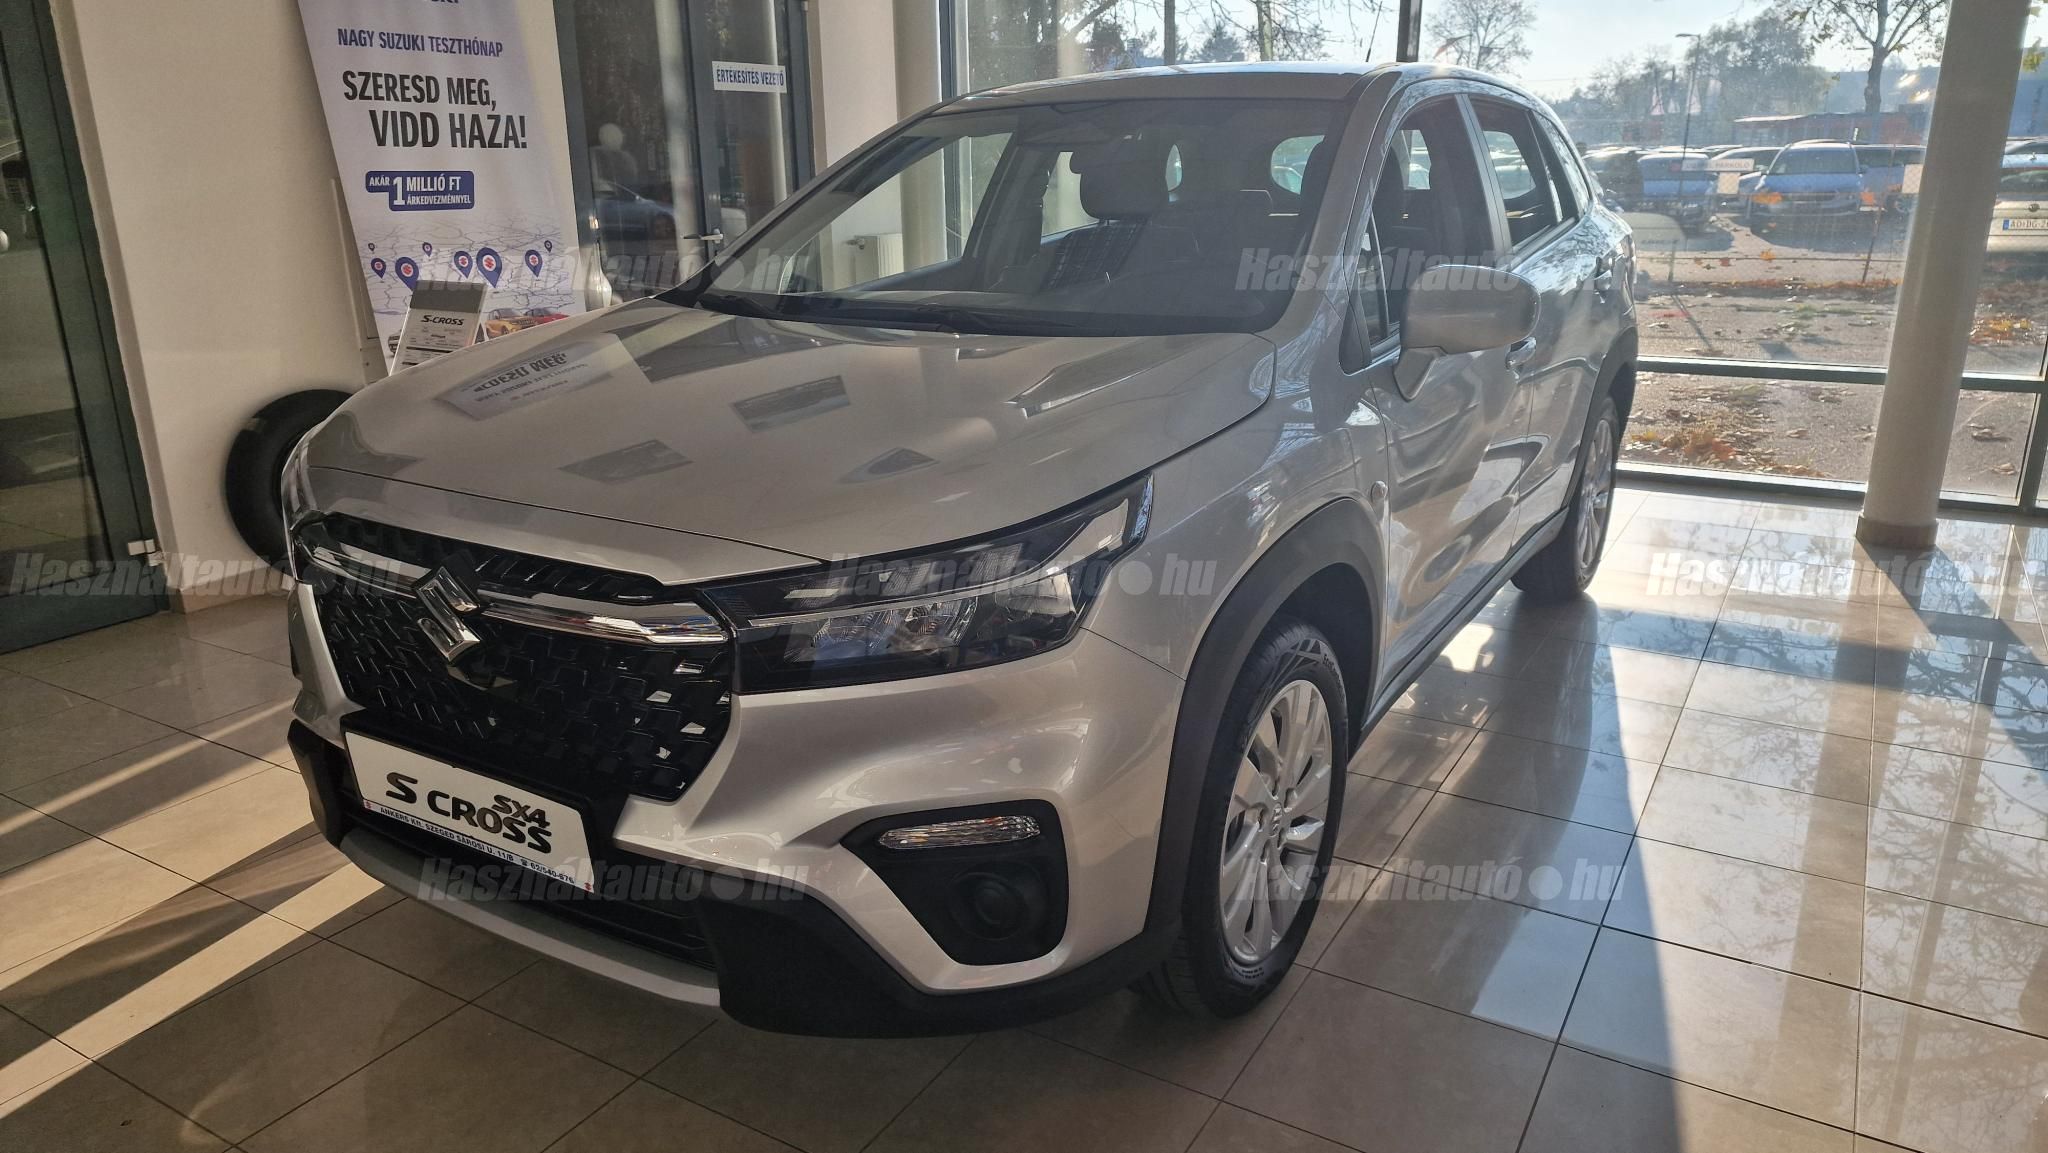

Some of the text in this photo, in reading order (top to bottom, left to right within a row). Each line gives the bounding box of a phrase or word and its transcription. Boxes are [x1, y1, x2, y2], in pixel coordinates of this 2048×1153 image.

[337, 28, 503, 57] NAGY SUZUKI TESZTHÓNAP
[342, 70, 497, 111] SZERESD MEG,
[368, 110, 528, 149] VIDD HAZA!
[369, 173, 462, 206] AKÁR 1 MILLIÓ FT
[406, 194, 472, 206] ÁRKEDVEZMÉNNYEL
[421, 314, 465, 326] S-CROSS
[380, 807, 410, 822] ANKERS
[425, 823, 455, 840] SZEGED
[385, 772, 553, 854] S CROSS
[491, 794, 551, 829] SX4
